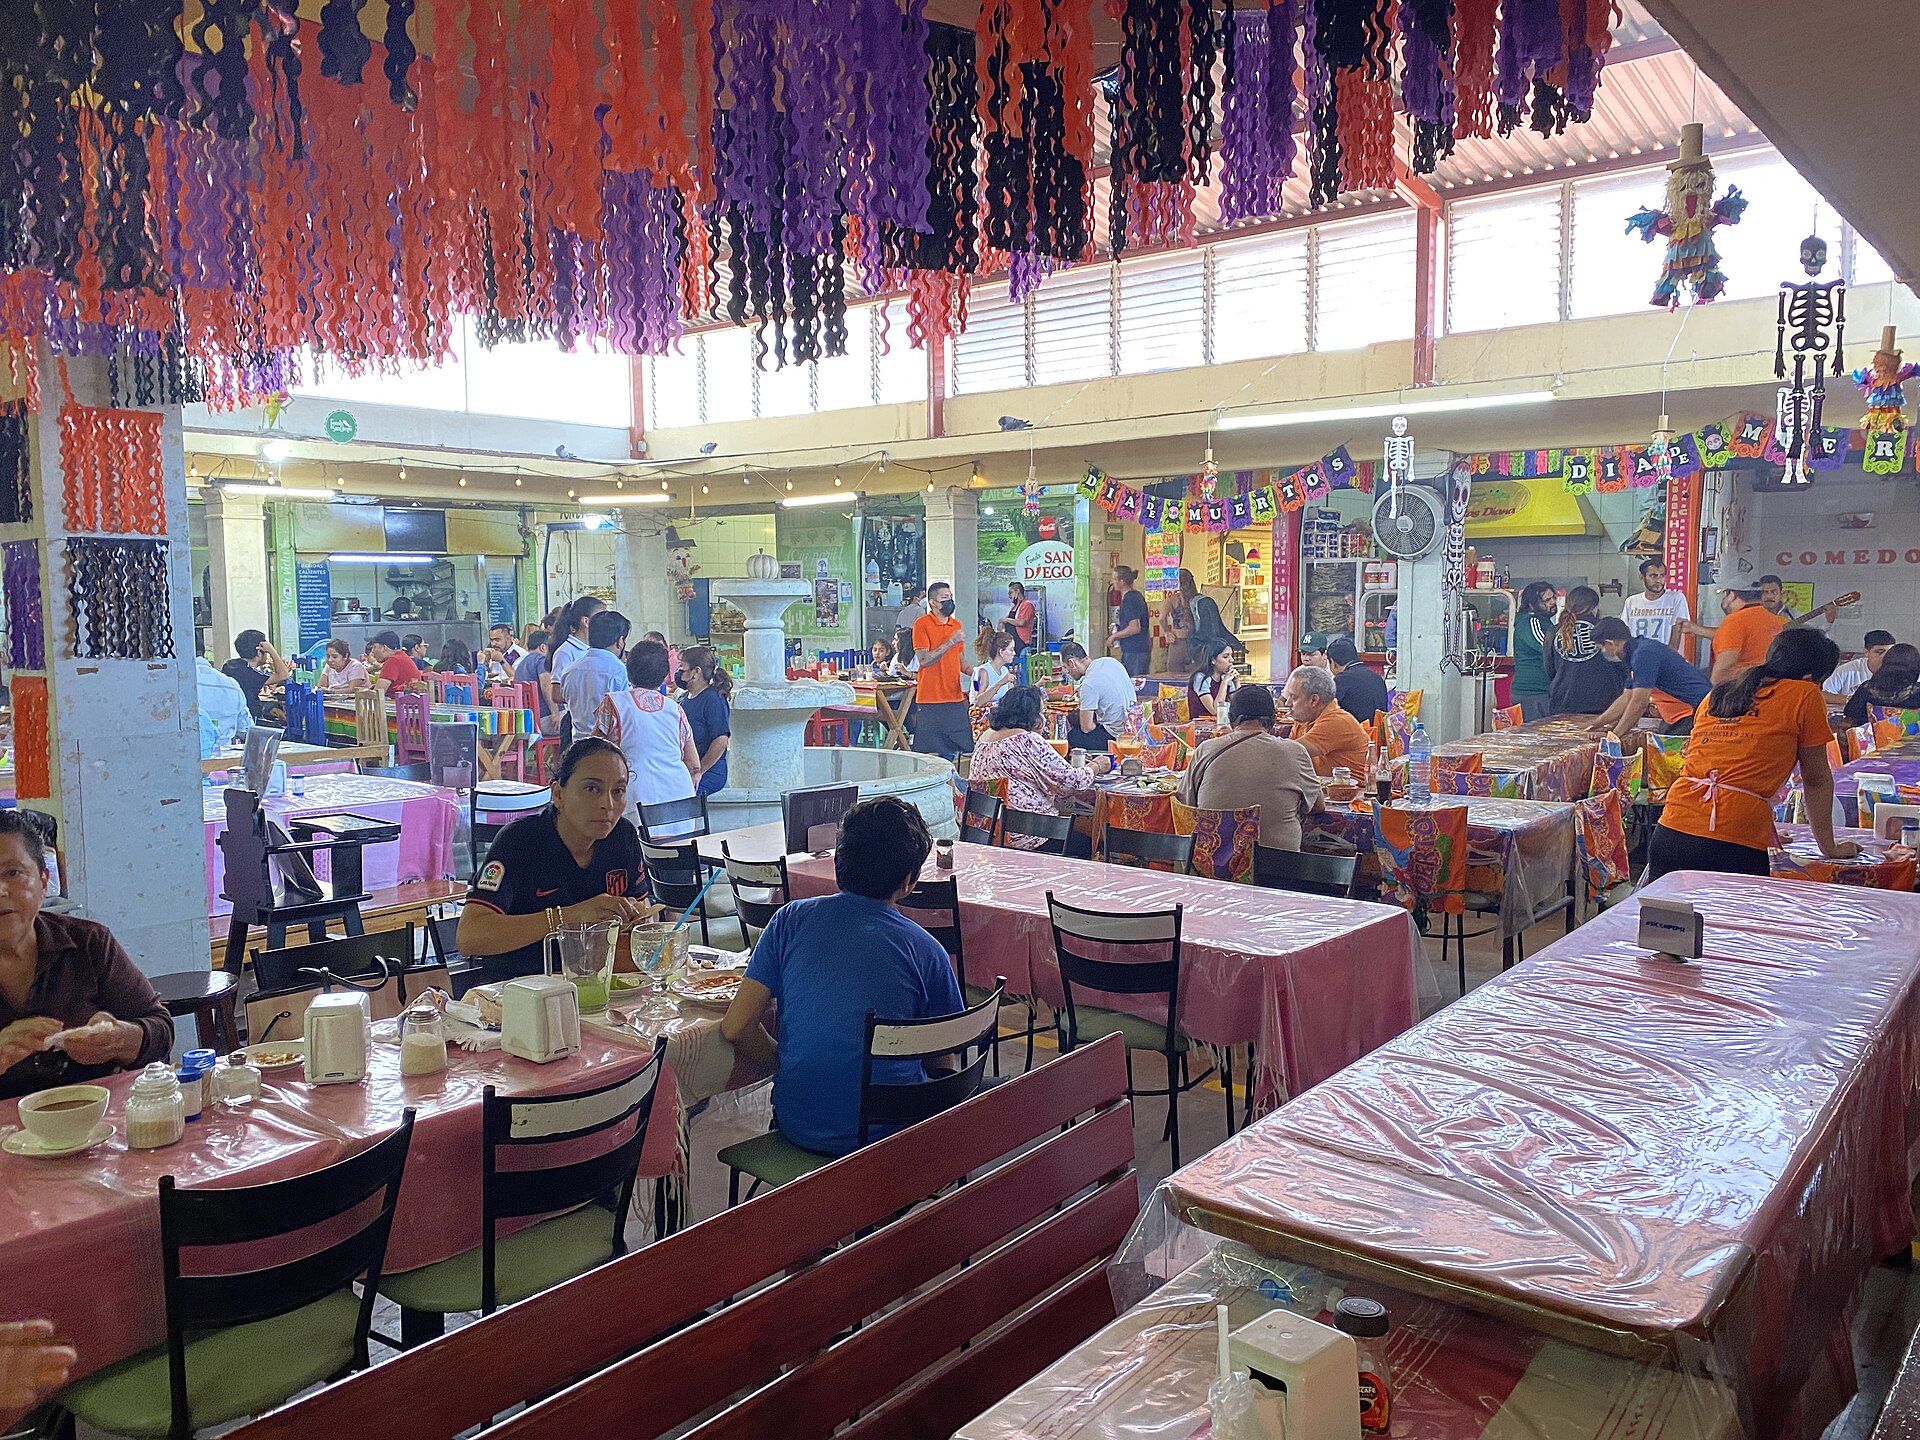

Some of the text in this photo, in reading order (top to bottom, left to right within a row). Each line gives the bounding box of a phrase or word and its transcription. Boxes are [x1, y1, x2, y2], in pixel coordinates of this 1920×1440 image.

[1572, 447, 1690, 479] DIA DE
[1086, 457, 1344, 521] DIA DE MUERTOS
[1671, 477, 1679, 518] UBANA
[1044, 550, 1073, 564] SAN
[1775, 548, 1920, 567] COMEDO
[1024, 564, 1073, 579] DIEGO
[1635, 618, 1664, 639] 87
